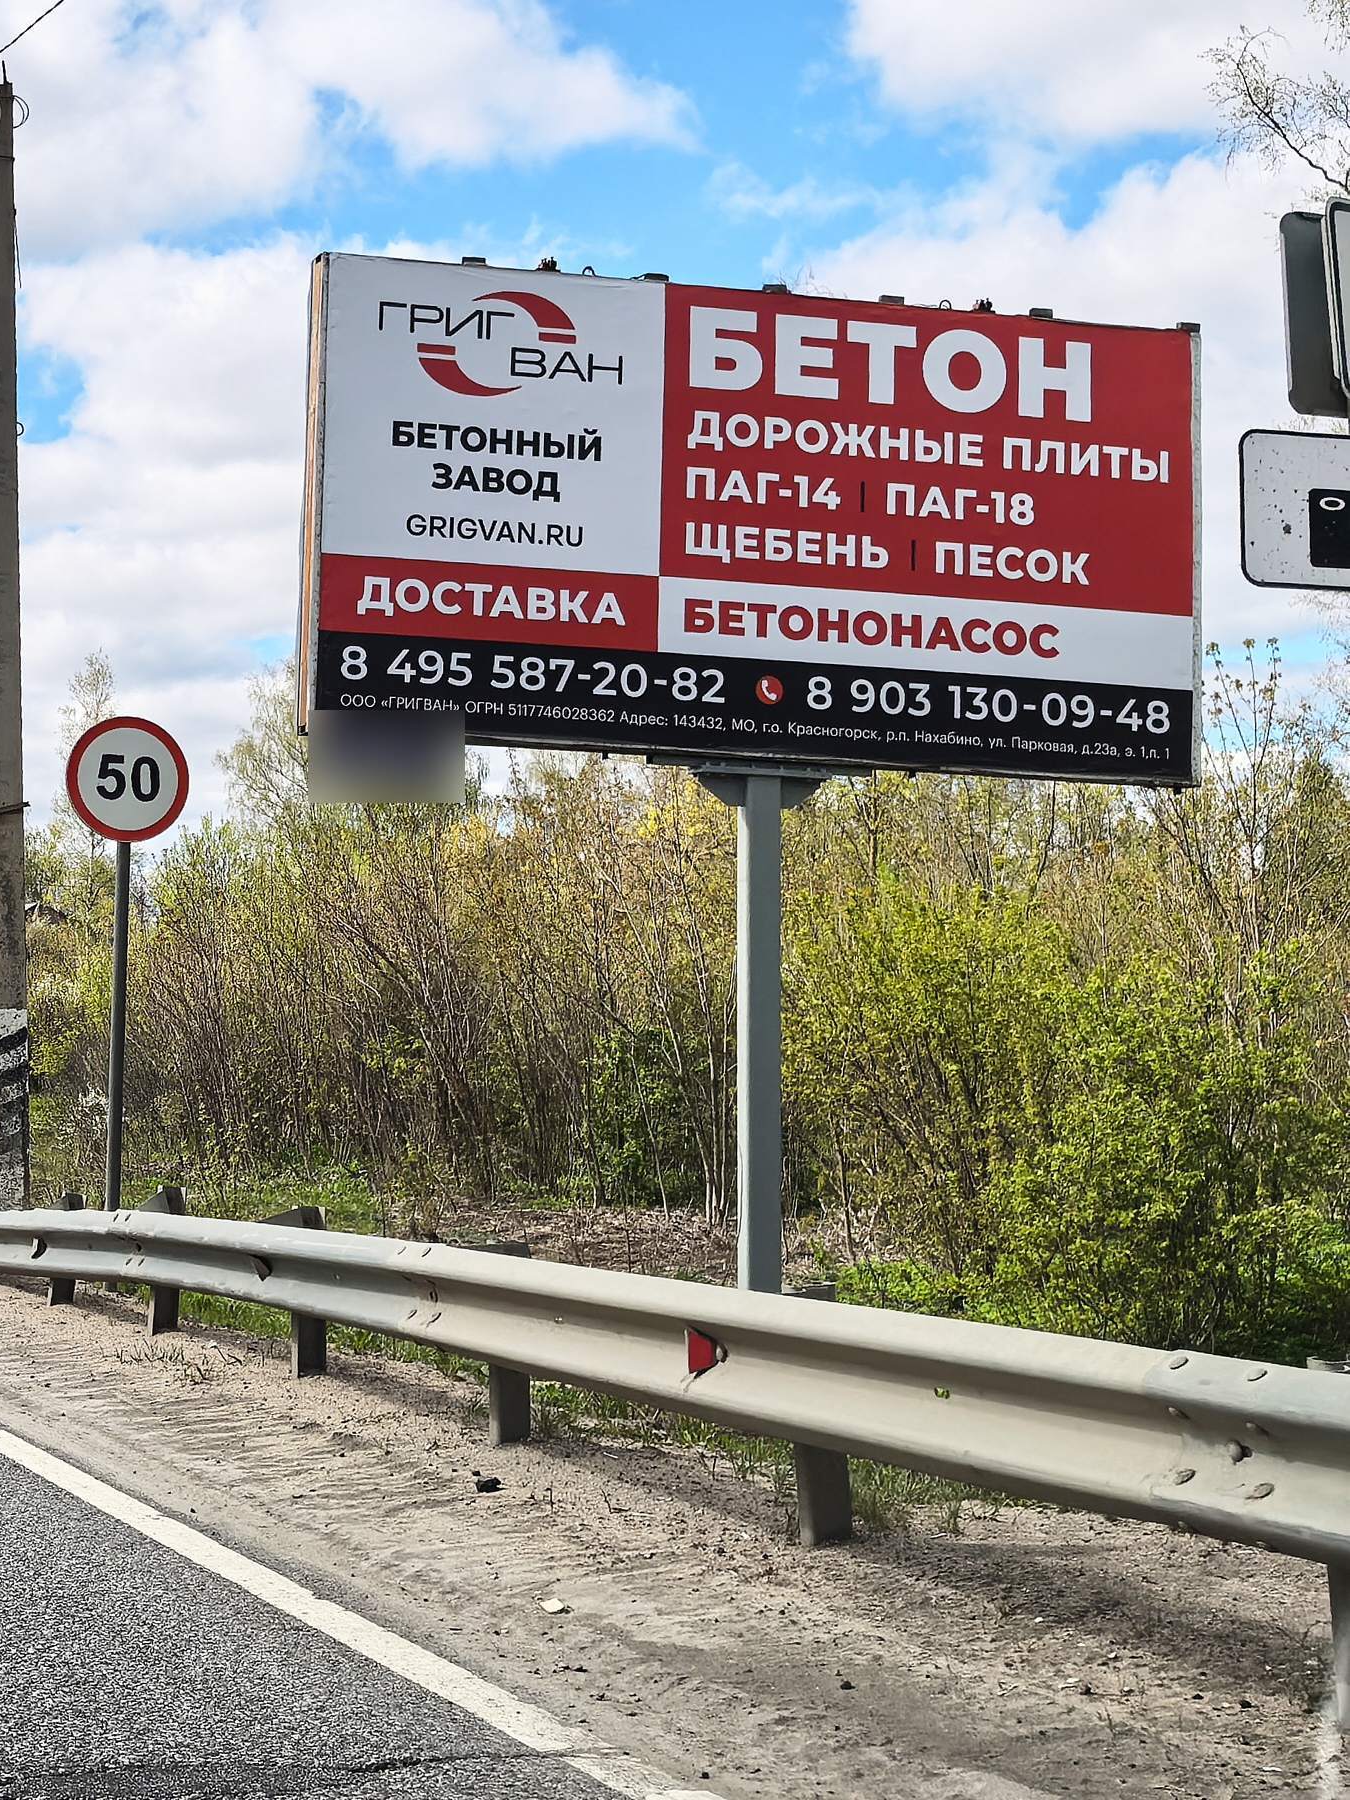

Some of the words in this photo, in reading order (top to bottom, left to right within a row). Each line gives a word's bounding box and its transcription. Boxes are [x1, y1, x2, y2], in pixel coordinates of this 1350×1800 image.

[378, 301, 515, 340] ГРИГ
[511, 346, 623, 385] ВАН
[689, 305, 1092, 423] БЕТОН
[392, 420, 602, 462] БЕТОННЫЙ
[687, 410, 985, 468] ДОРОЖНЫЕ
[1002, 436, 1169, 484] ПЛИТЫ
[431, 462, 561, 503] ЗАВОД
[686, 466, 841, 510] ПАГ-14
[886, 482, 1035, 526] ПАГ-18
[406, 513, 584, 548] GRIGVAN.RU
[685, 521, 889, 569] ЩЕБЕНЬ
[935, 541, 1090, 586] ПЕСОК
[356, 576, 626, 626] ДОСТАВКА
[683, 598, 1060, 659] БЕТОНОНАСОС
[340, 645, 368, 681] 8
[386, 648, 473, 687] 495
[490, 655, 726, 704] 587-20-82
[340, 693, 377, 708] ООО
[380, 696, 460, 711] «ГРИГВАН»
[464, 700, 504, 715] ОГРН
[508, 703, 615, 723] 5117746028362
[619, 710, 668, 727] Адрес:
[673, 714, 727, 732] 143432,
[731, 718, 758, 734] МО,
[762, 723, 783, 734] г.о.
[788, 721, 882, 742] Красногорск,
[886, 730, 910, 743] р.п.
[914, 730, 984, 748] Нахабино,
[988, 737, 1007, 749] ул.
[1011, 736, 1078, 755] Парковая,
[806, 675, 833, 710] 8
[850, 678, 931, 717] 903
[948, 684, 1171, 734] 130-09-48
[96, 753, 161, 803] 50
